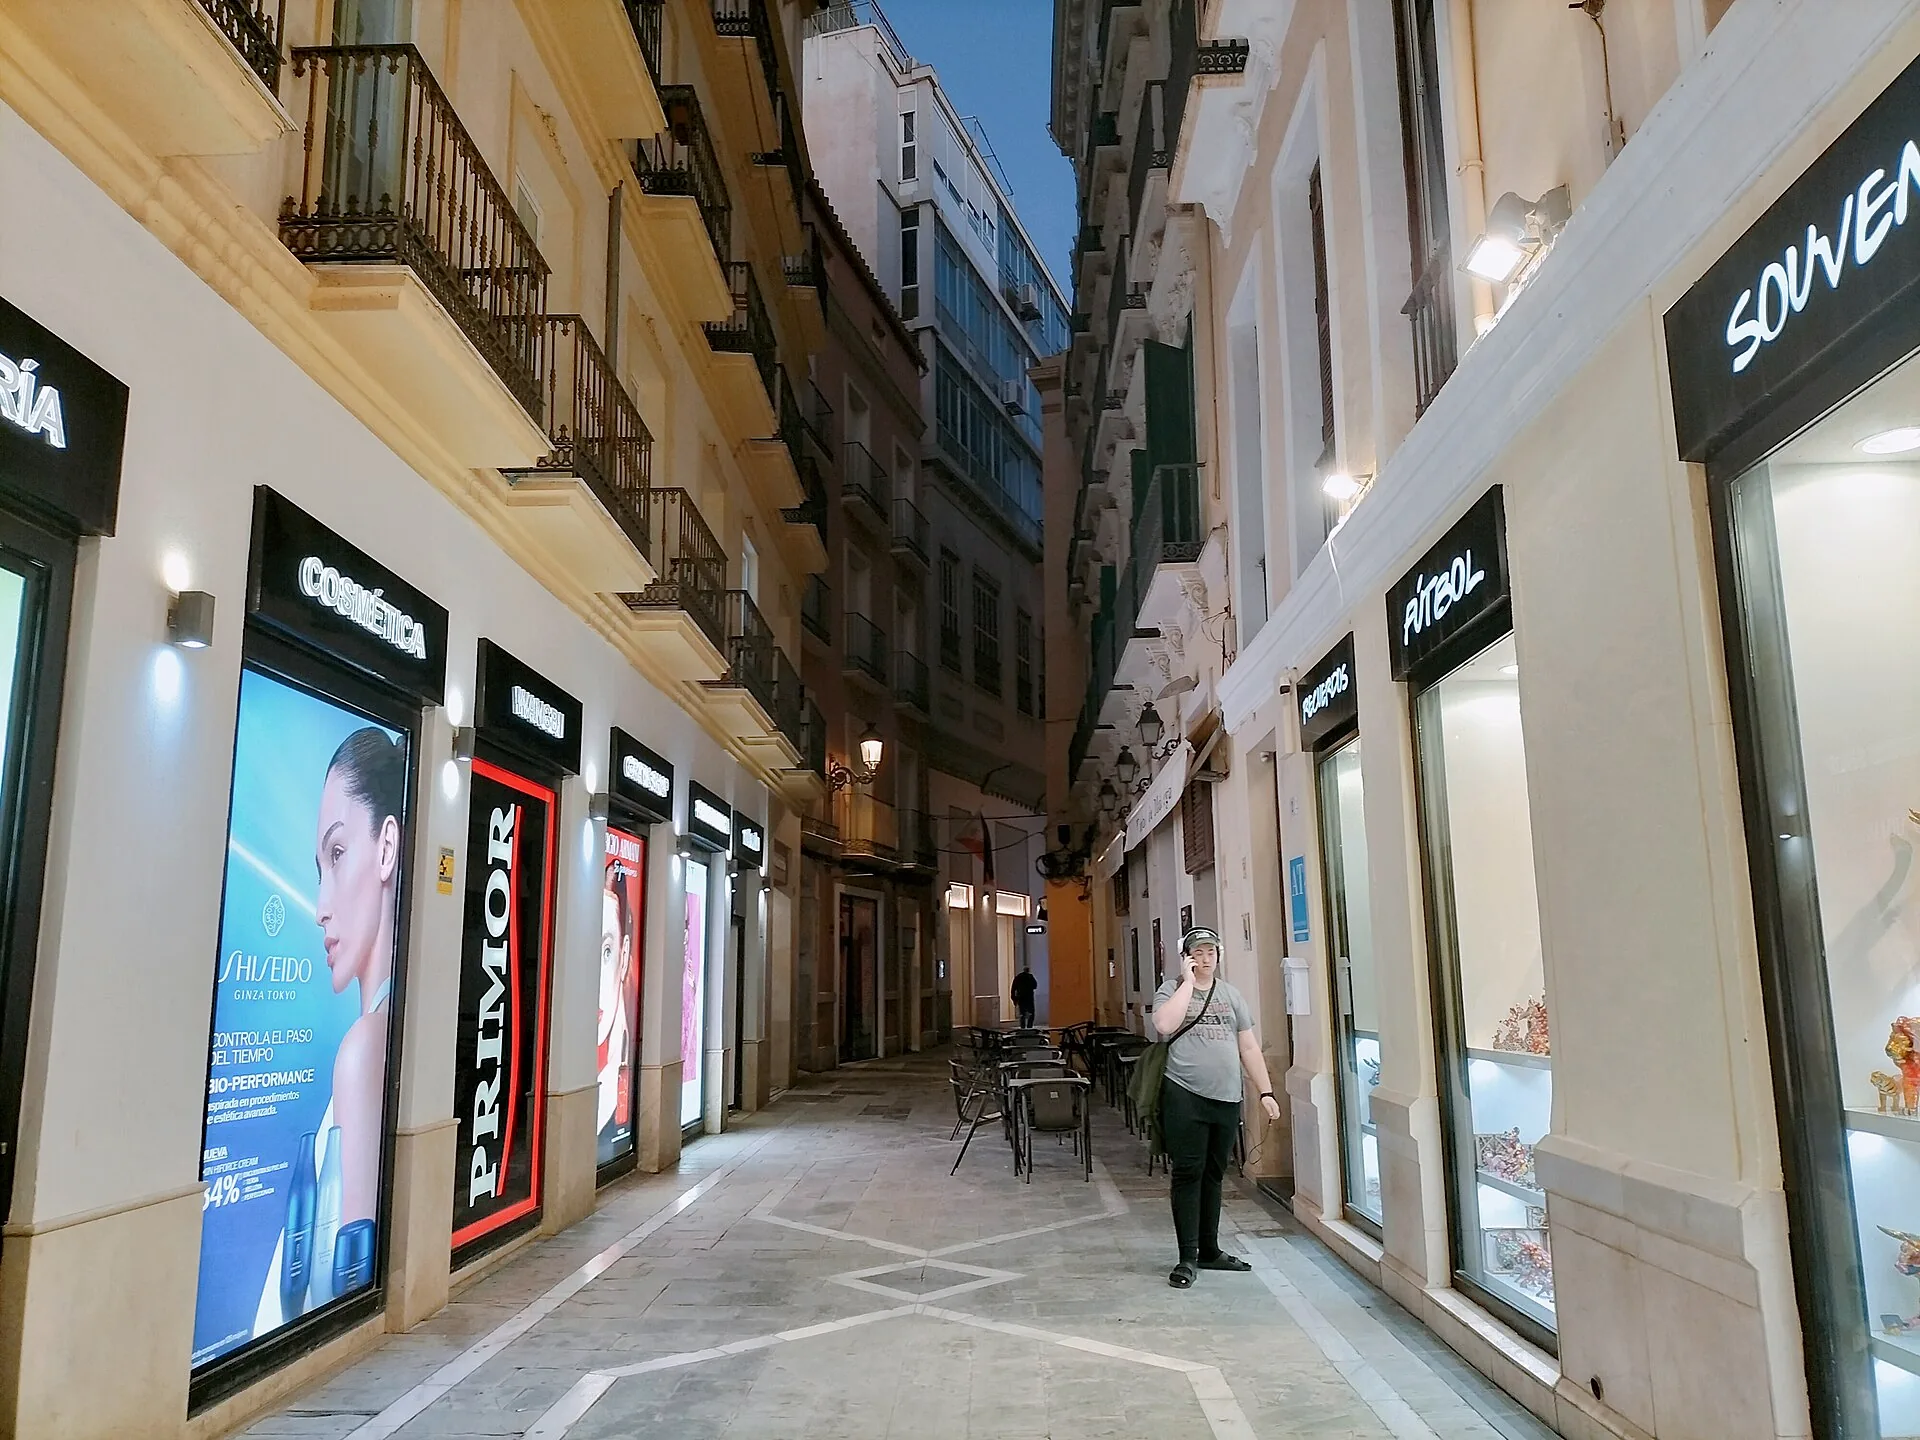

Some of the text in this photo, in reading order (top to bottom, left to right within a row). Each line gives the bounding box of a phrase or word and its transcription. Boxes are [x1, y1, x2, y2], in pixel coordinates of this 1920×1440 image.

[298, 556, 427, 659] COSMÉTICA
[1302, 663, 1349, 725] RECUERDOS
[218, 950, 312, 983] SHISEIDO
[234, 989, 296, 1001] GINZA TOKYO
[469, 803, 516, 1207] PRIMOR
[213, 1028, 313, 1048] CONTROLA EL PASO
[232, 1047, 274, 1064] TIEMPO
[250, 1091, 300, 1108] procedimientos
